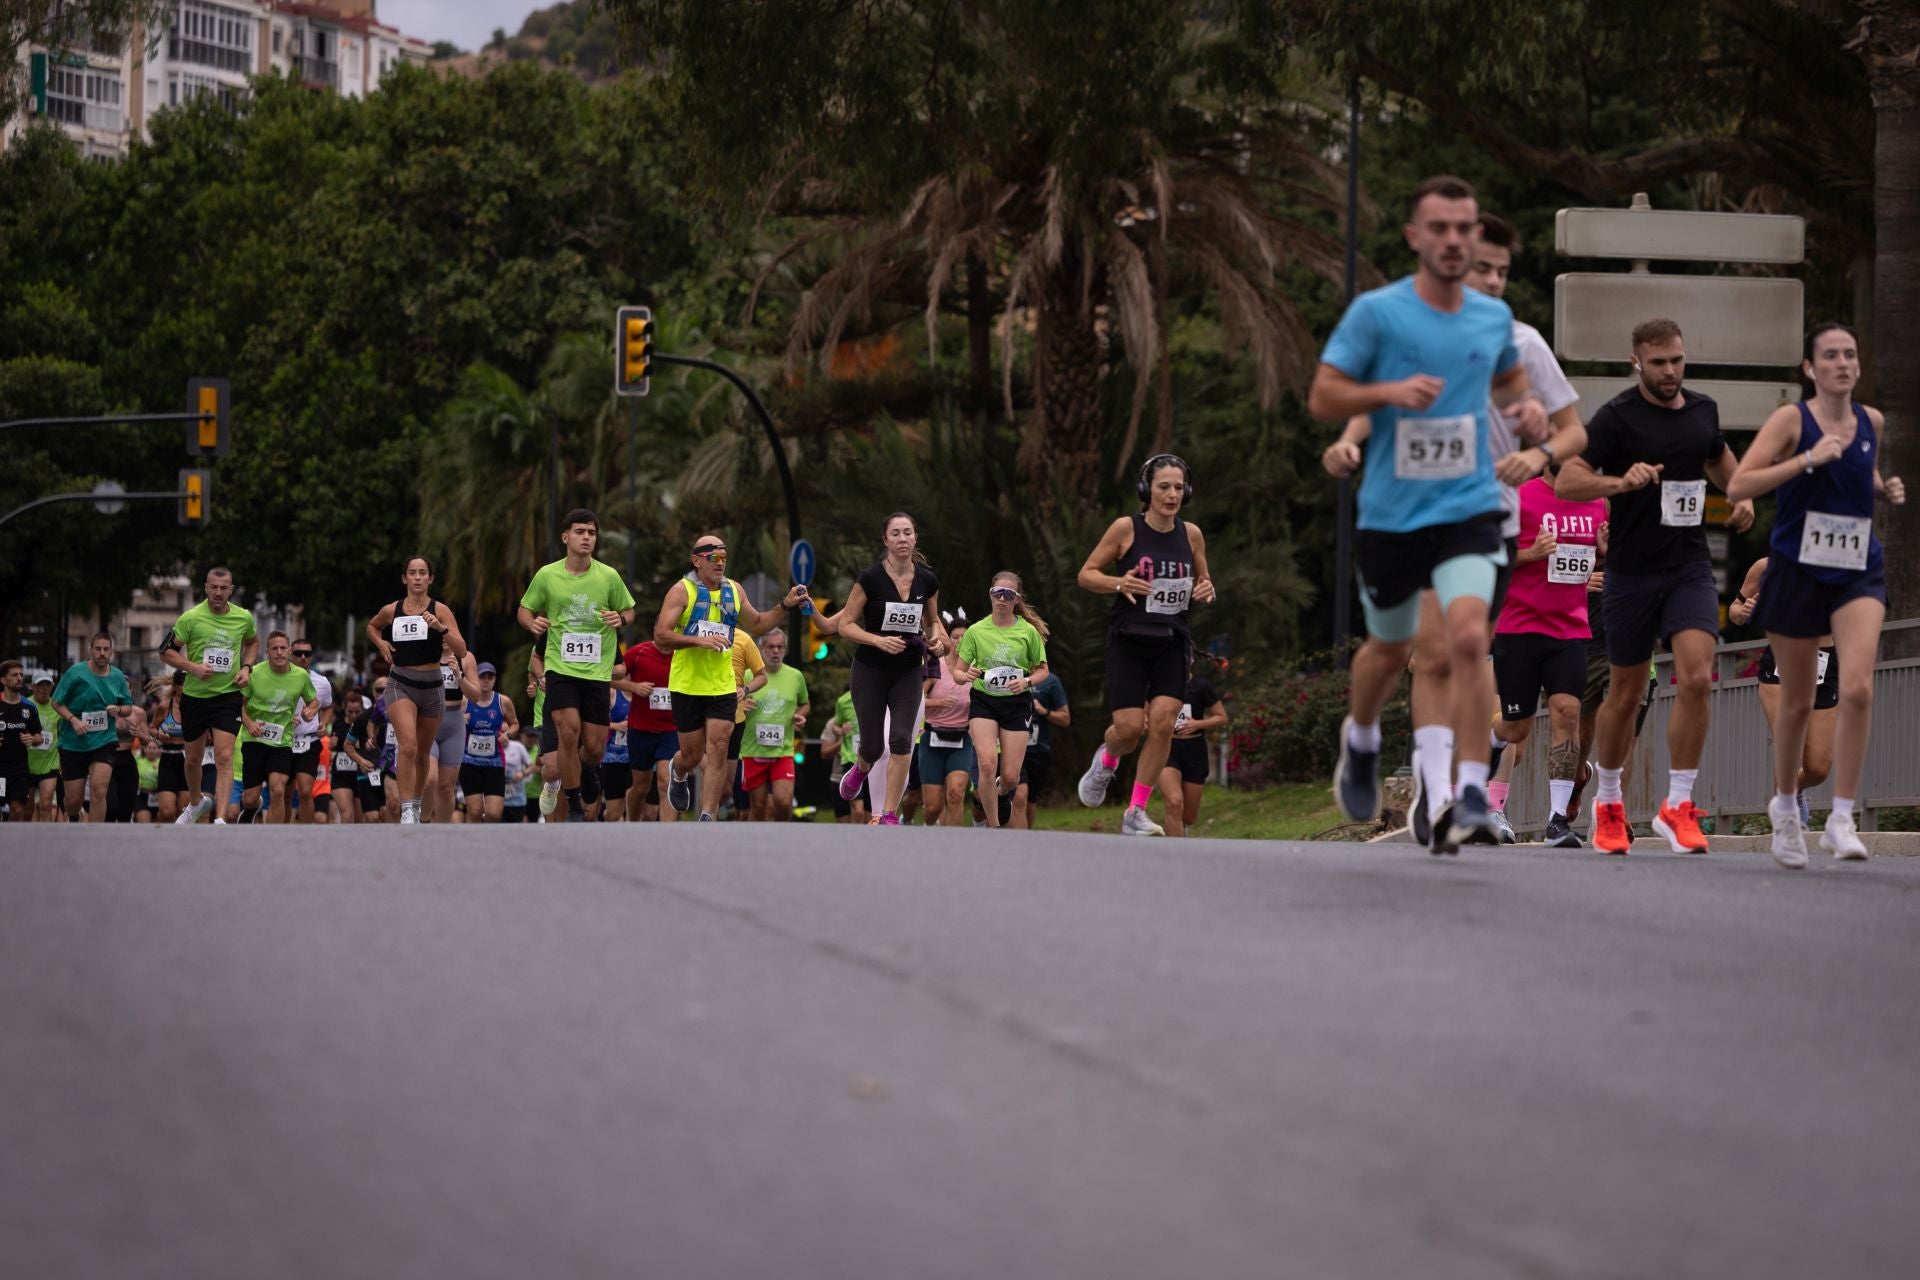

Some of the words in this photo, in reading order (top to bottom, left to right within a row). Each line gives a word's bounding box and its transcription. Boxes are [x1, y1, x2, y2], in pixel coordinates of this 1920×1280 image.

[1409, 438, 1465, 461] 579
[1676, 497, 1697, 512] 19
[1811, 530, 1859, 550] 1111
[1556, 557, 1589, 573] 566
[1154, 590, 1186, 604] 480
[889, 613, 916, 624] 639
[401, 623, 418, 633] 16
[566, 642, 593, 654] 811
[208, 655, 230, 667] 569
[86, 717, 104, 727] 768
[263, 729, 278, 739] 67
[759, 731, 780, 740] 244
[294, 740, 307, 749] 37
[472, 741, 492, 751] 722
